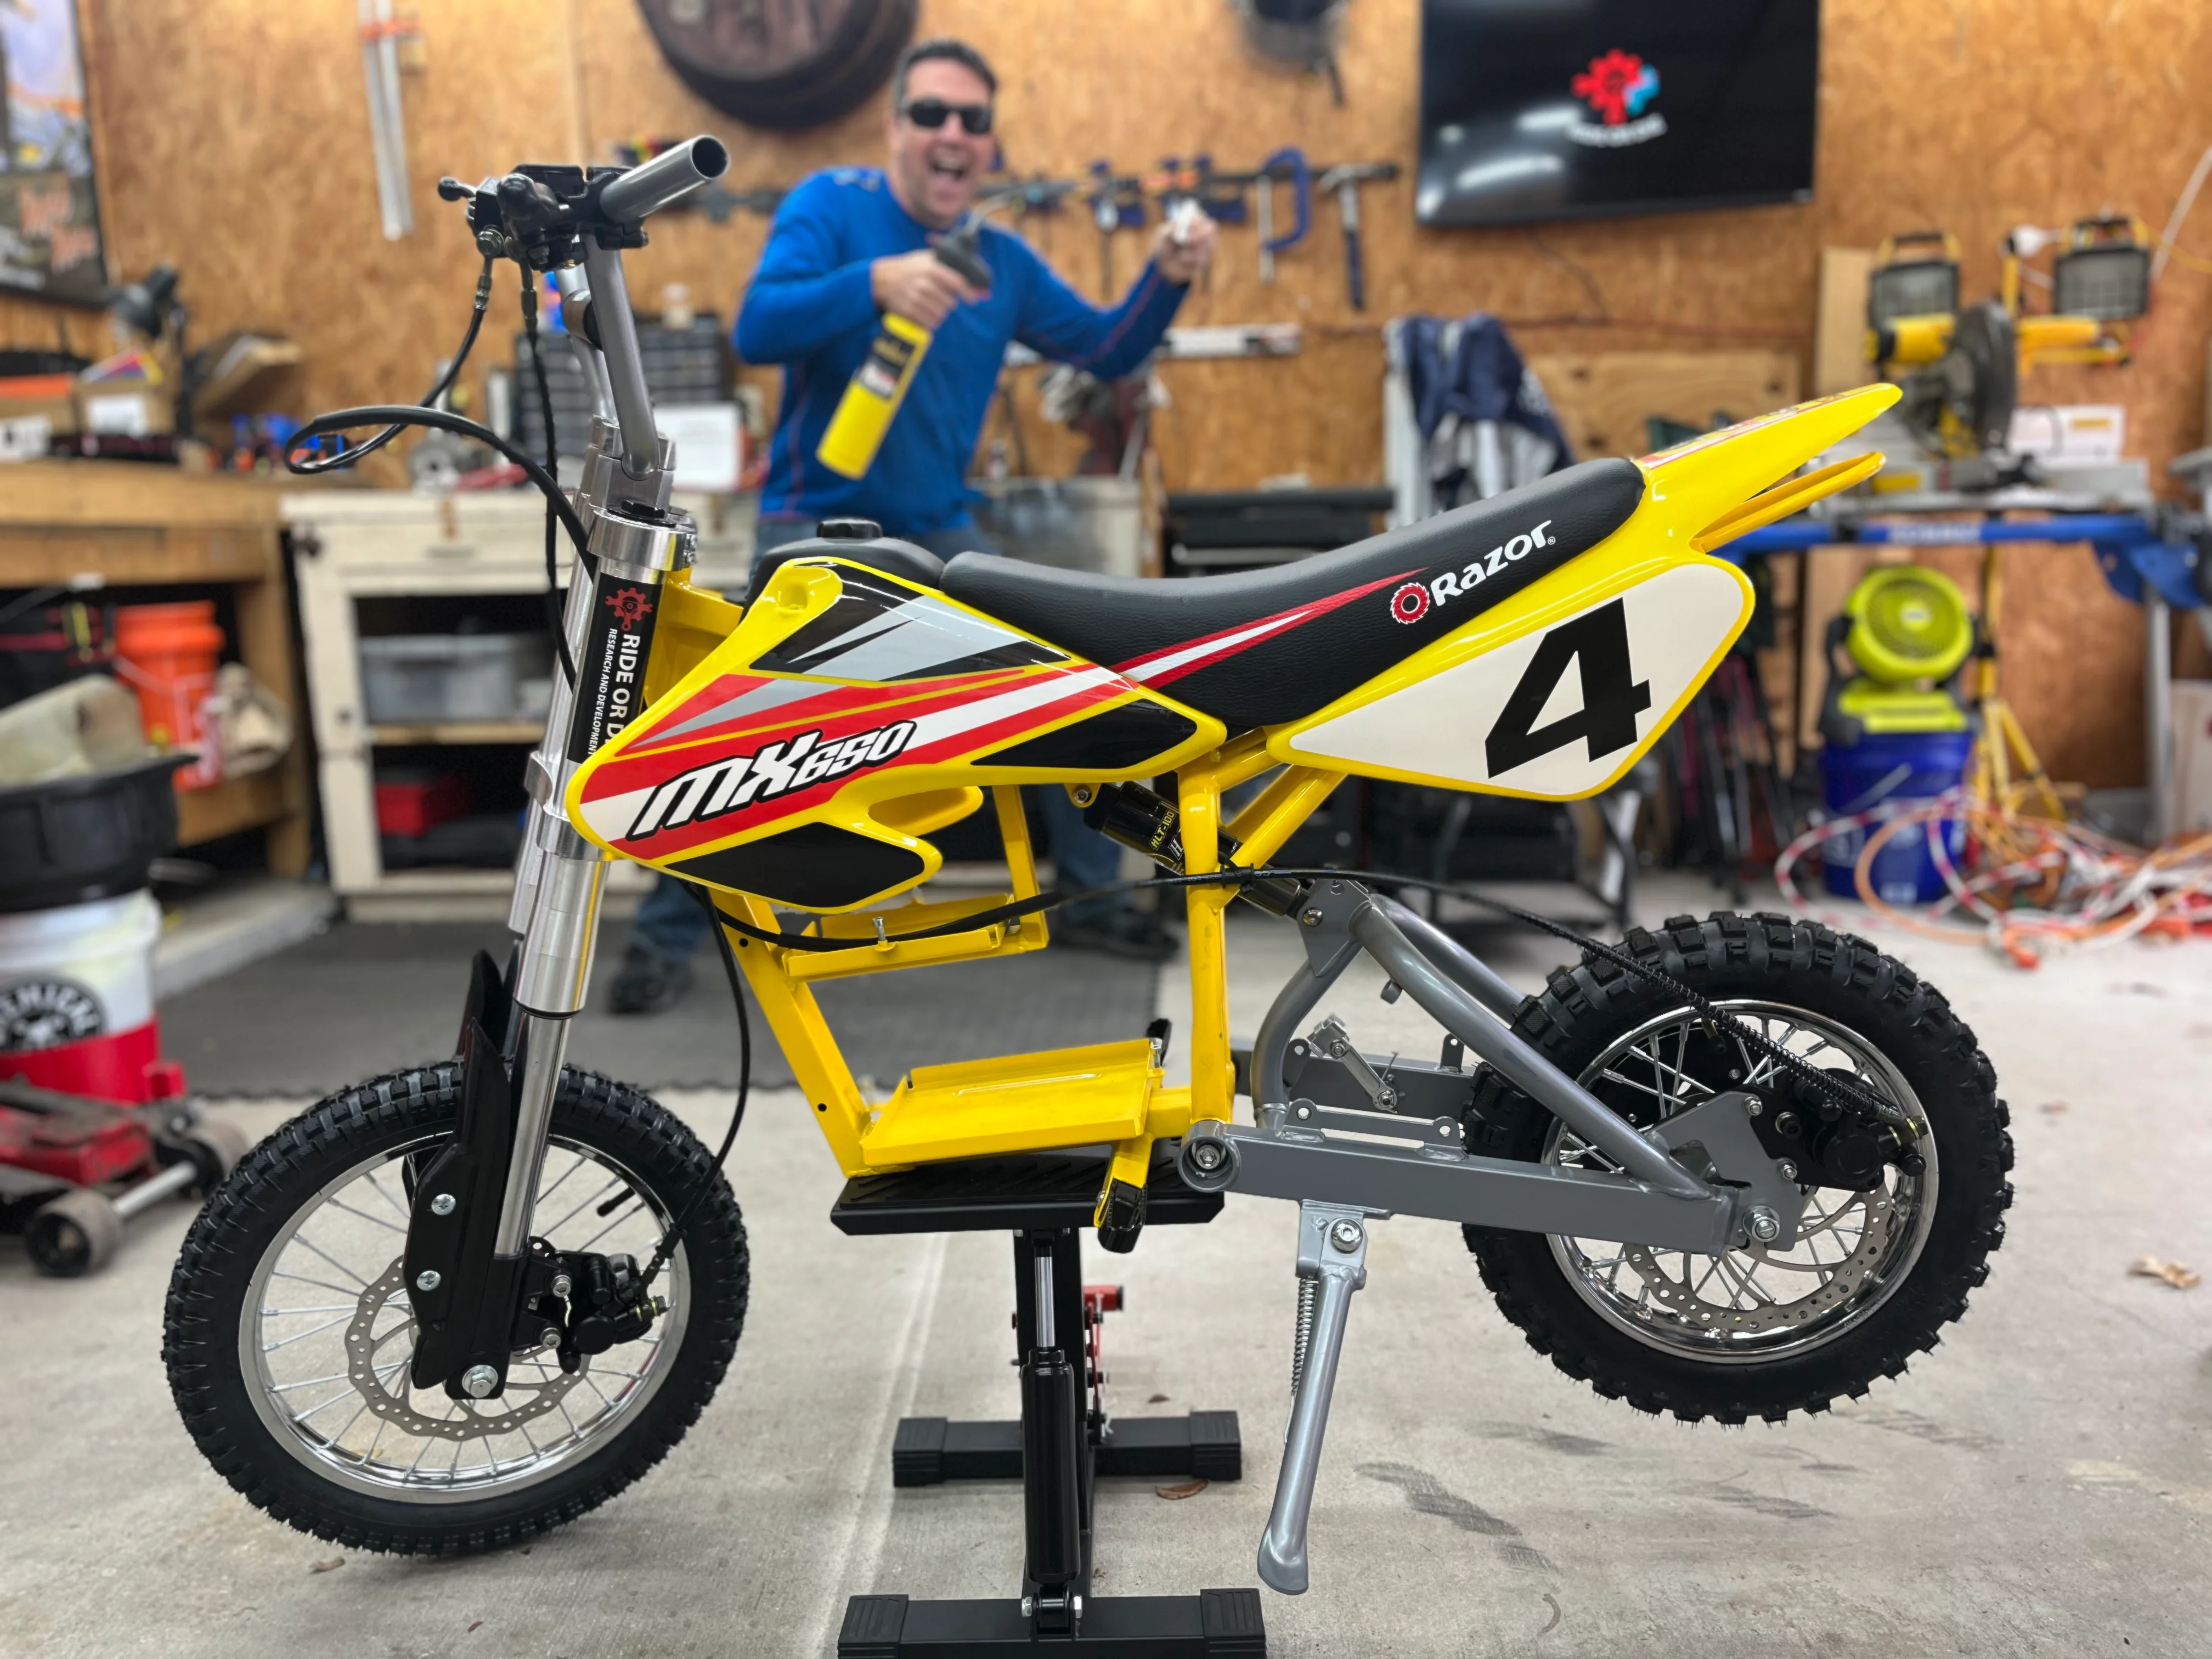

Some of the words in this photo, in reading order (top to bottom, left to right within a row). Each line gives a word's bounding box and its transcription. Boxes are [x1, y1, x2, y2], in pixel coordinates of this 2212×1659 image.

[602, 628, 618, 675] RESEARCH
[616, 634, 641, 684] RIDE
[599, 675, 610, 694] AND
[608, 689, 630, 719] OR
[1485, 597, 1651, 778] 4
[1150, 810, 1175, 849] HLT-100
